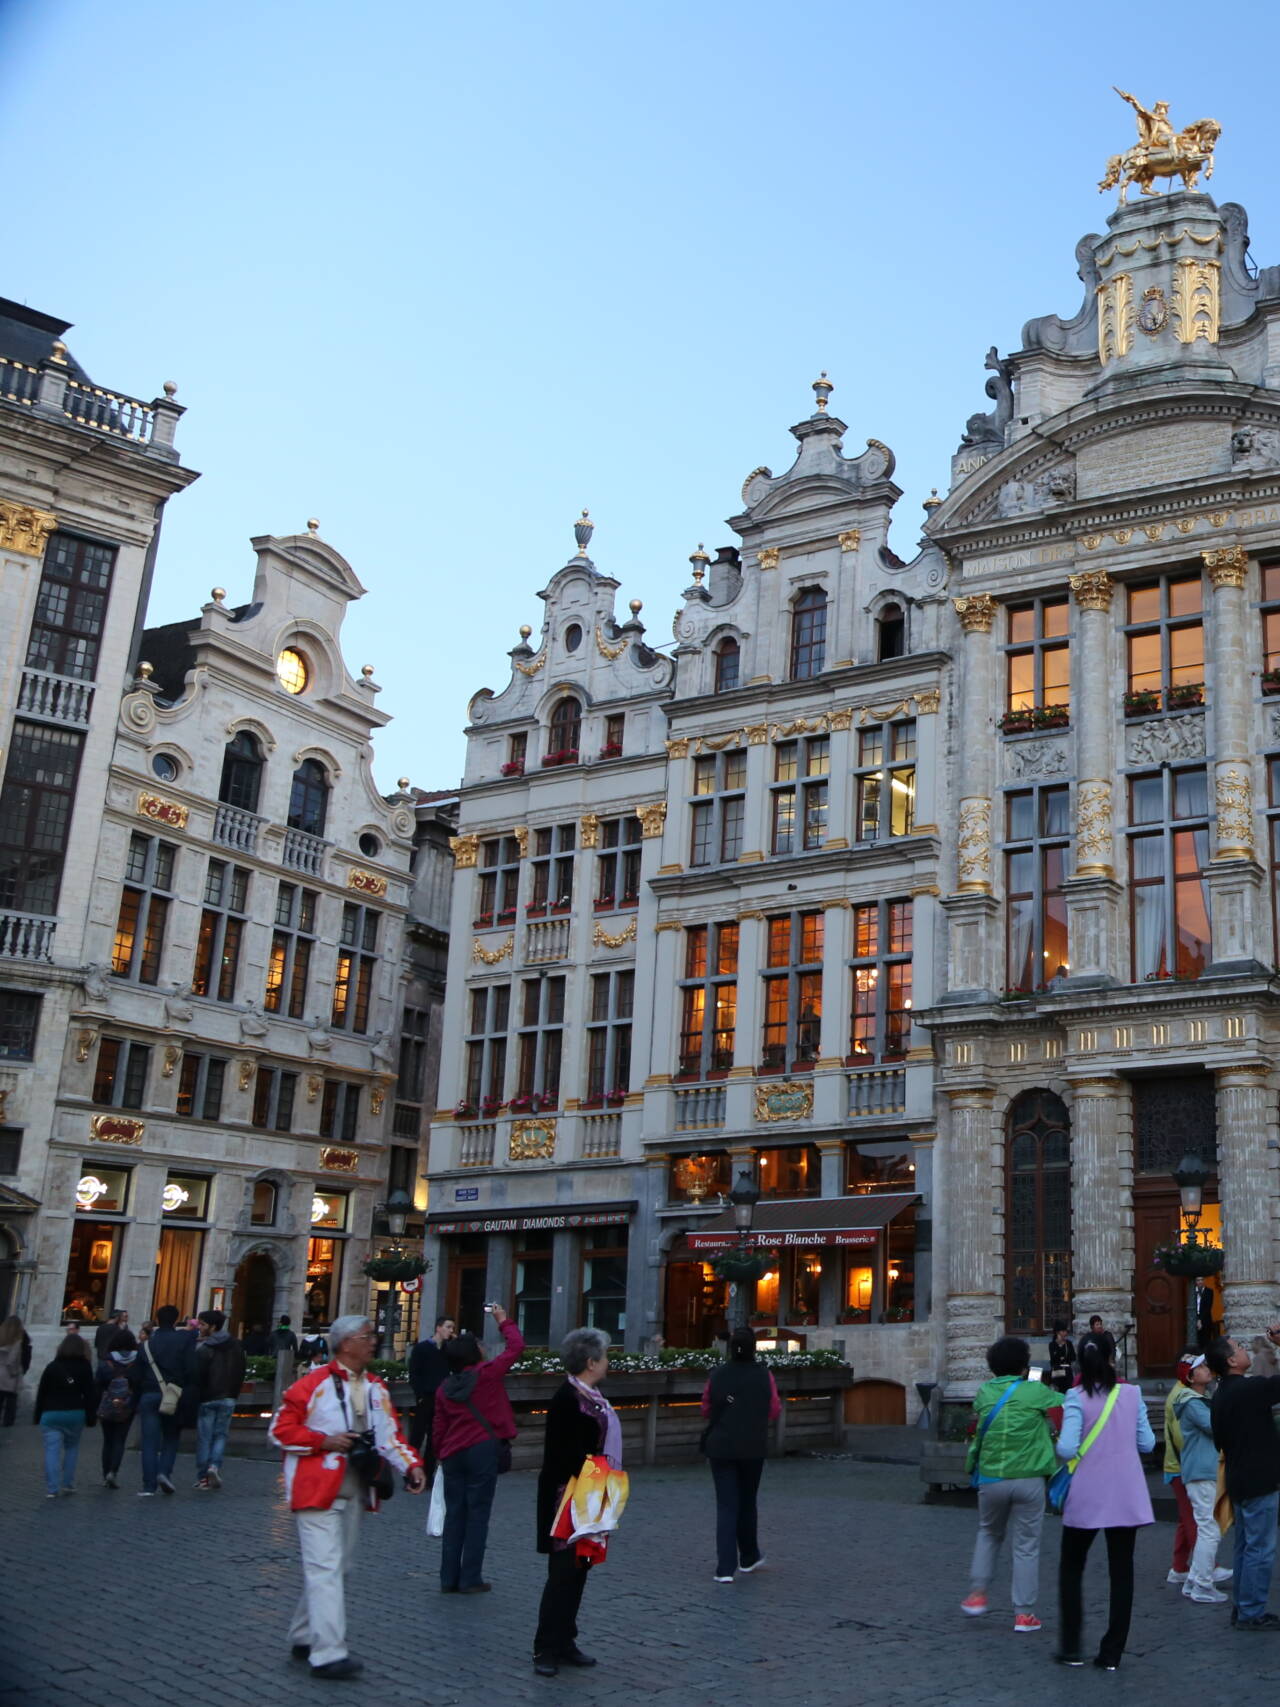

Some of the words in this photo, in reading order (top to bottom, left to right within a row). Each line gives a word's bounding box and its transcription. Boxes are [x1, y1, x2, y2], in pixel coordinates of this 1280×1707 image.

[967, 550, 1031, 577] MAISON
[1040, 542, 1074, 563] DES
[484, 1219, 517, 1232] GAUTAM
[522, 1215, 566, 1230] DIAMONDS
[757, 1233, 782, 1246] Rose
[784, 1232, 827, 1246] Blanche
[835, 1235, 870, 1245] Brasserie
